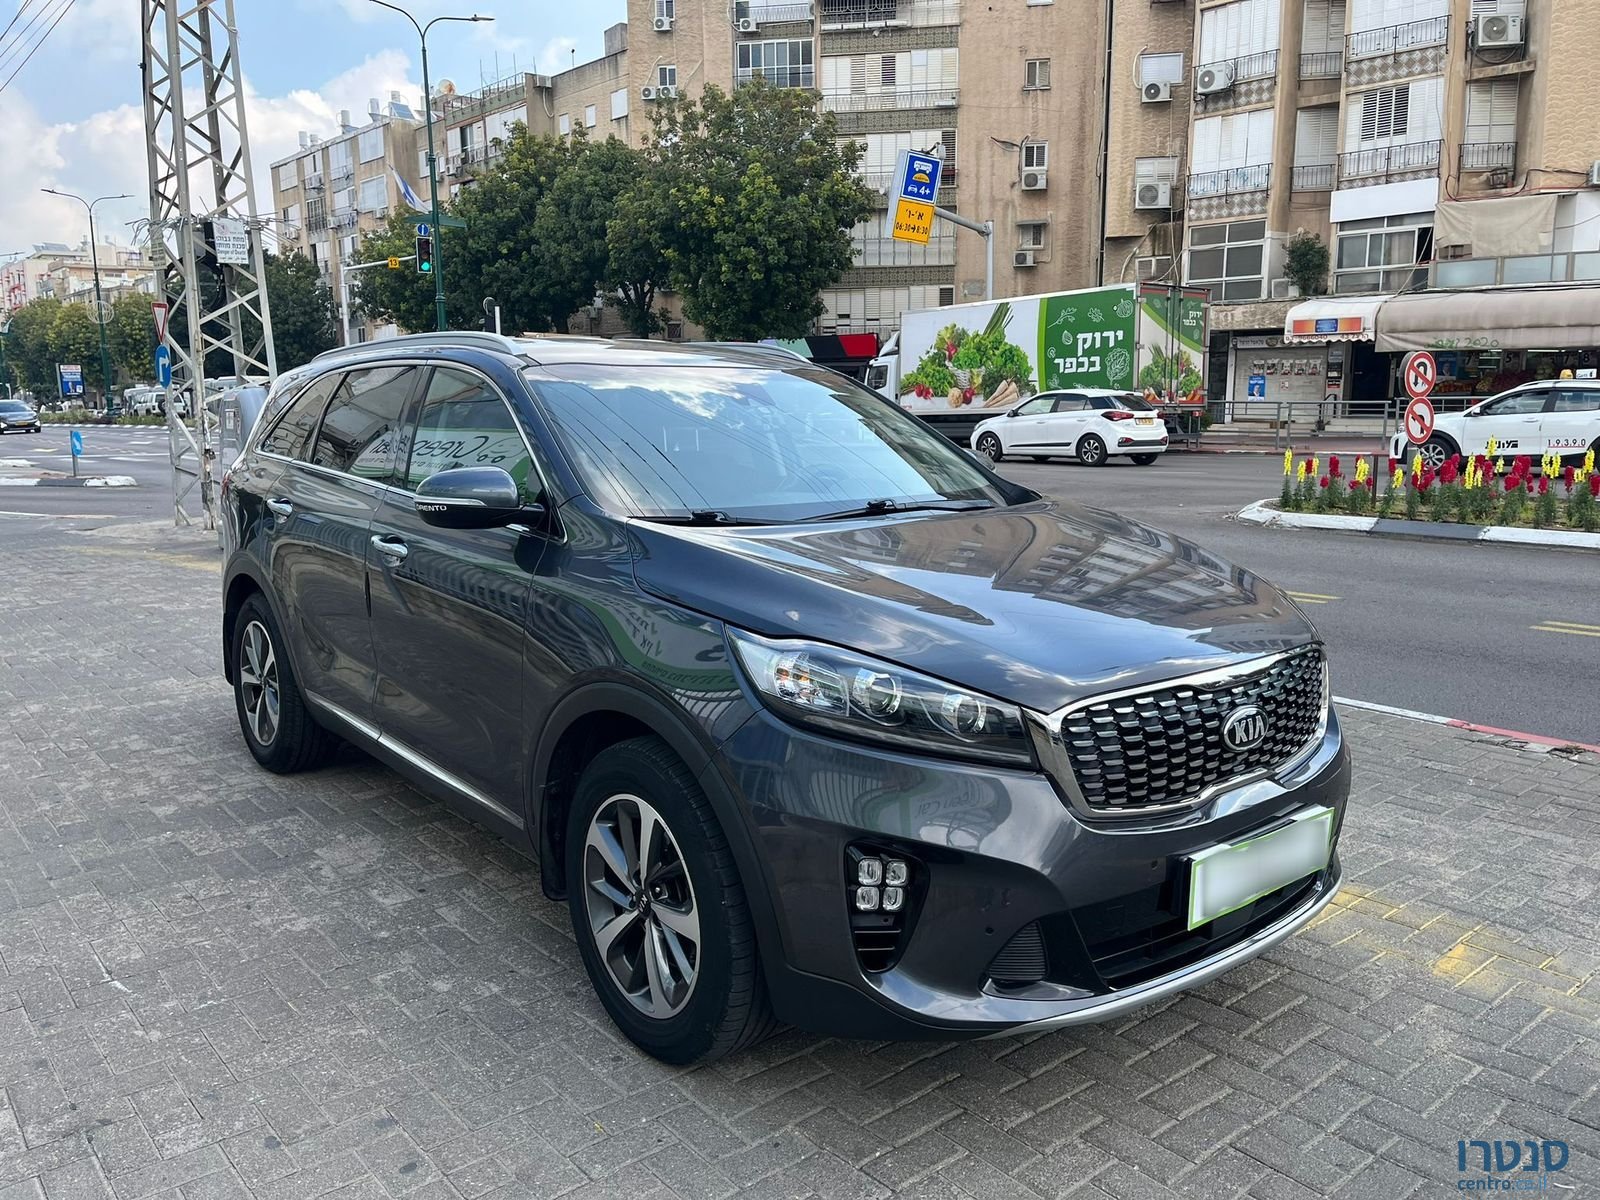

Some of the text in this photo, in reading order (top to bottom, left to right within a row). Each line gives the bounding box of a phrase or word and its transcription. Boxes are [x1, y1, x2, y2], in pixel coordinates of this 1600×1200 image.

[919, 186, 930, 195] 4+
[390, 258, 398, 266] 13
[1189, 311, 1202, 320] ירוק
[1076, 330, 1124, 357] ירוק
[1464, 337, 1500, 348] 2020
[1053, 356, 1102, 374] בכפר
[1234, 715, 1265, 744] KIA
